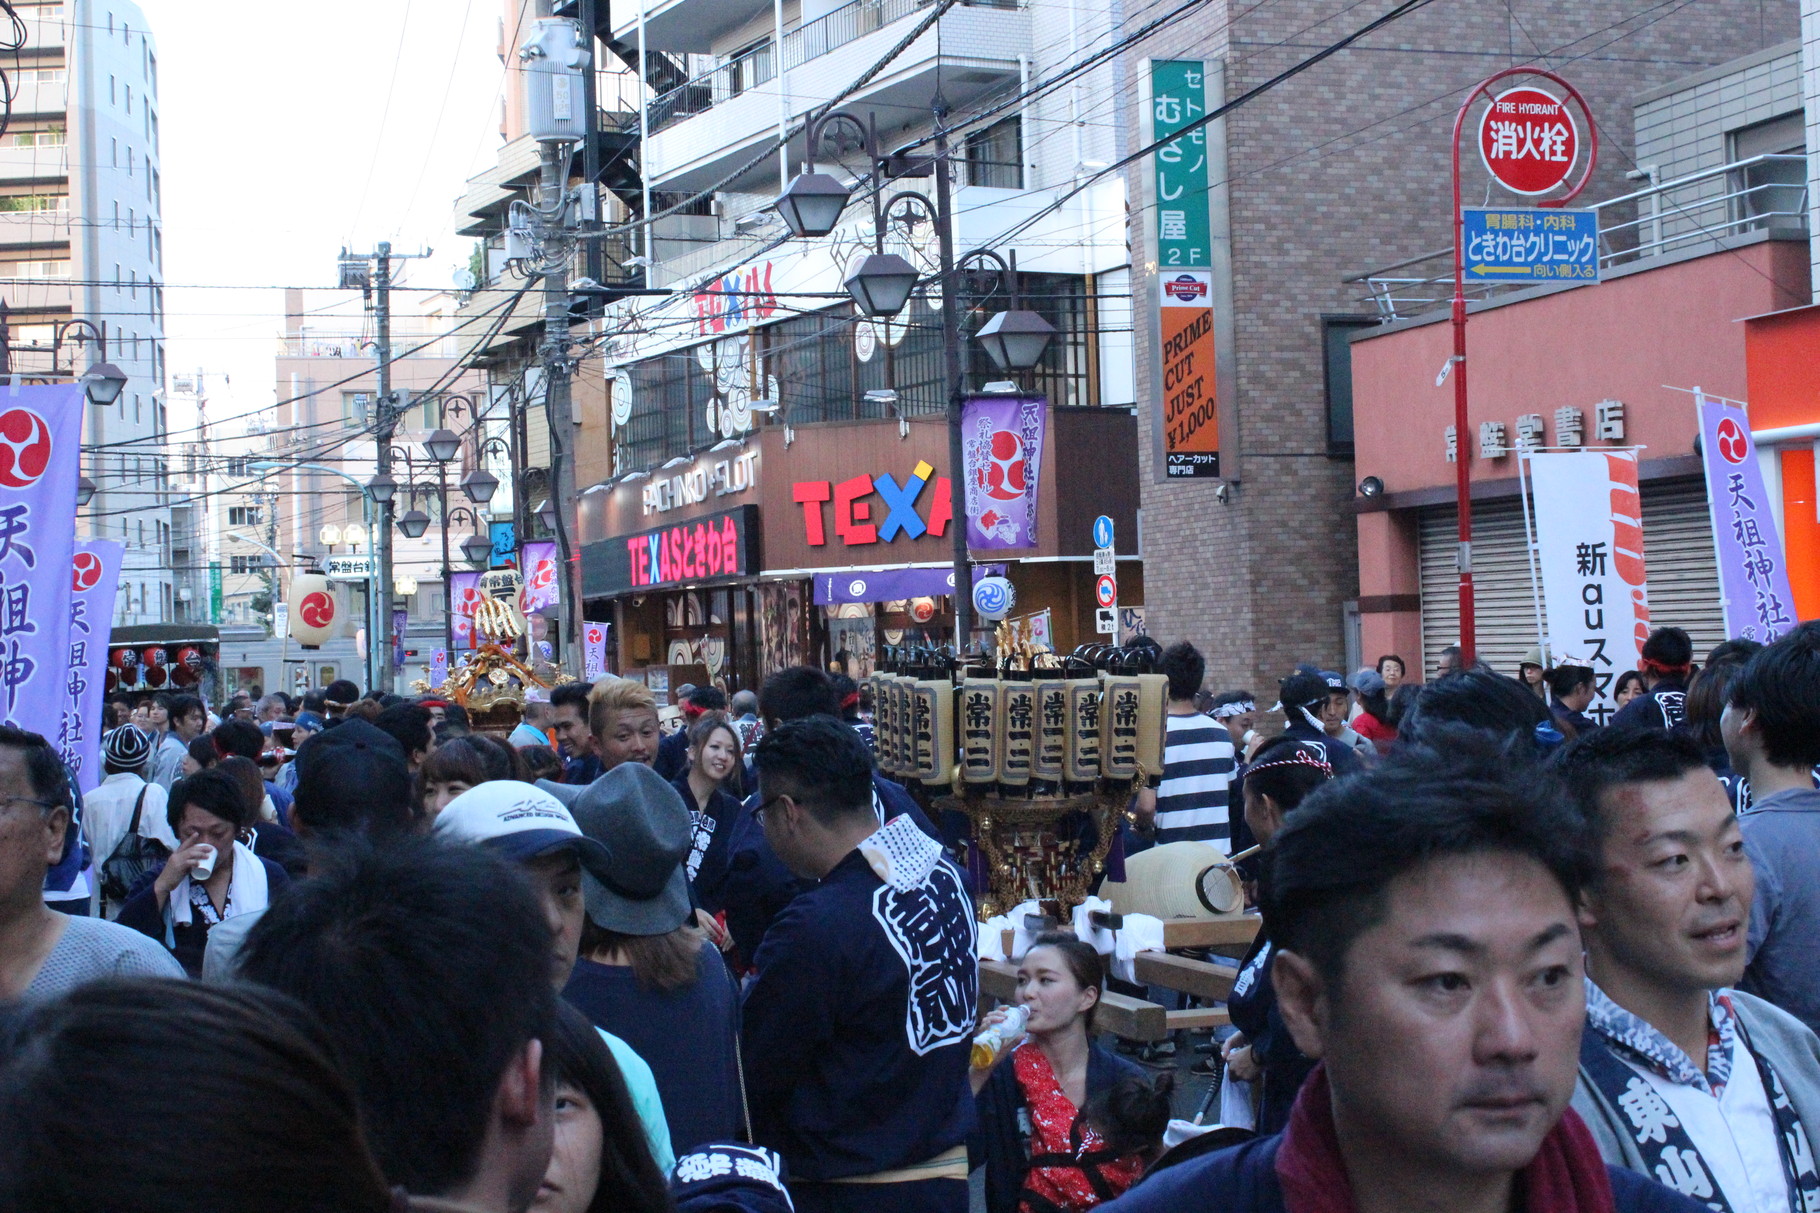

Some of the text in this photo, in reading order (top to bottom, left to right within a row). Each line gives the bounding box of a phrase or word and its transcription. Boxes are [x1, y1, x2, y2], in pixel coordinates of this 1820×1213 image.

[1184, 70, 1204, 172] セトモノ
[1496, 102, 1560, 116] FIRE HYDRANT
[1490, 120, 1569, 162] 消火栓
[1156, 94, 1187, 240] むさし屋
[1468, 230, 1594, 262] ときわ台クリニック
[1486, 214, 1576, 230] 胃腸科・内科
[1534, 264, 1595, 278] 向い側入る
[1164, 310, 1212, 365] PRIME
[1165, 351, 1194, 392] CUT
[1167, 375, 1204, 424] JUST
[1167, 397, 1215, 450] ¥1,000
[966, 439, 980, 516] 常盤台銀座商店街
[978, 416, 994, 494] 祭礼協賛セール
[1168, 454, 1216, 464] ヘアーカット
[1168, 465, 1194, 475] 専門店
[628, 516, 738, 586] TEXASときわ台
[1618, 1076, 1724, 1213] 東山
